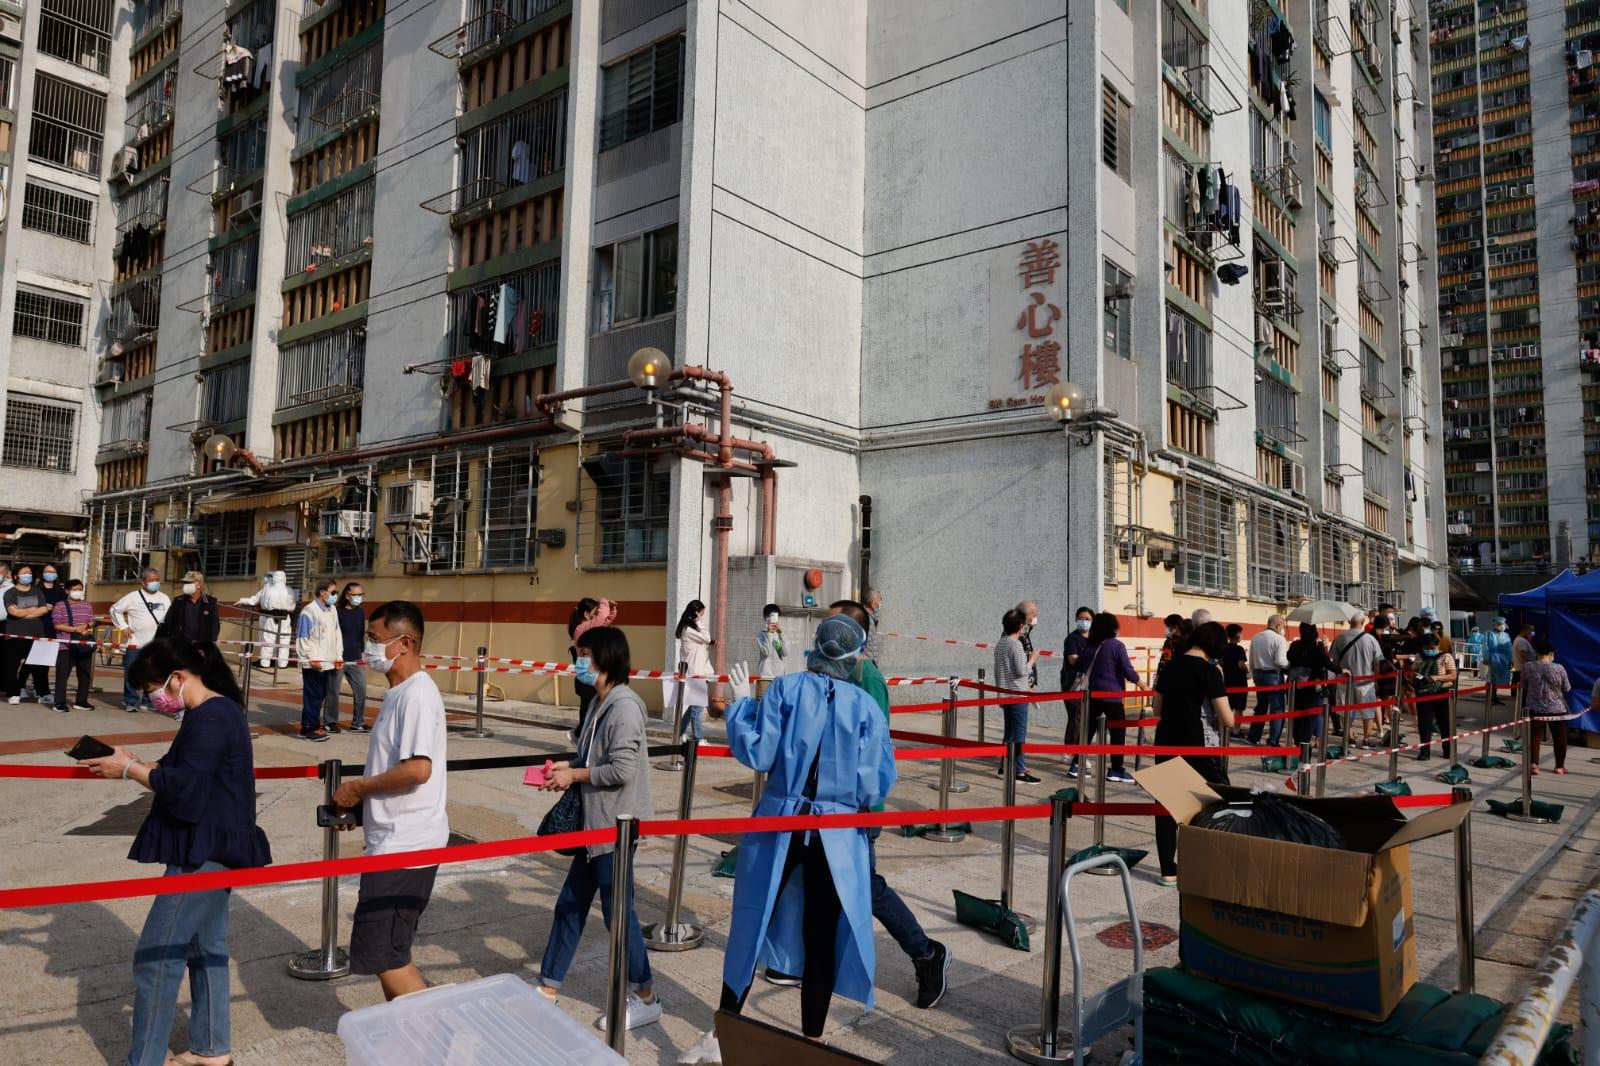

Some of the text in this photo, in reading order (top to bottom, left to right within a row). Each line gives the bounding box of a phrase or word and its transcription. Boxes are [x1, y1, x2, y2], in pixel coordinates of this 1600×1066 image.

[1017, 239, 1062, 390] 善心樓
[529, 576, 539, 586] 21
